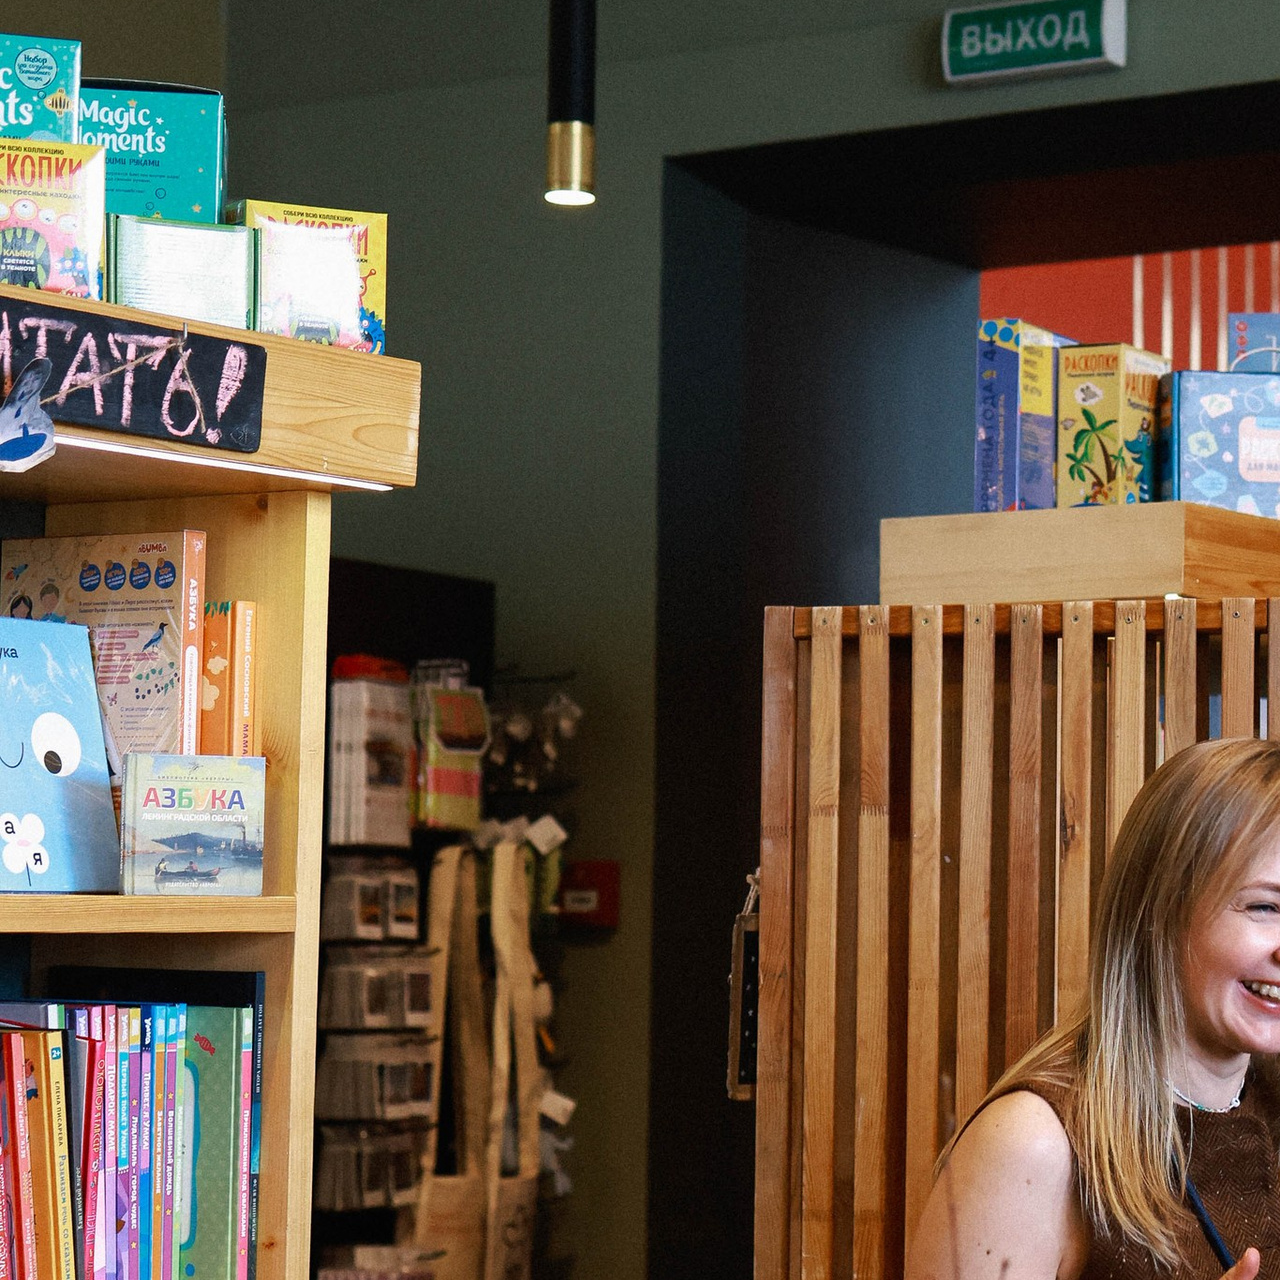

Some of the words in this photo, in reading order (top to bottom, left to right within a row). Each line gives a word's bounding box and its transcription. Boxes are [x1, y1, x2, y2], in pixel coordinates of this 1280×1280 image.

[960, 9, 1090, 58] ВЫХОД
[79, 98, 150, 133] Magic
[23, 146, 64, 155] КОЛЛЕКЦИЮ
[79, 125, 166, 154] oments
[283, 209, 304, 217] СОБЕРИ
[319, 214, 353, 222] КОЛЛЕКЦИЮ
[3, 249, 35, 258] КЛЫКИ
[1064, 354, 1118, 372] РАСКОПКИ
[188, 578, 198, 631] АЗБУКА
[244, 609, 254, 652] Евгений
[242, 654, 253, 717] Сосновский
[142, 787, 246, 811] АЗБУКА
[4, 820, 16, 834] а
[142, 813, 211, 822] ЛЕНИНГРАДСКОЙ
[211, 814, 249, 822] ОБЛАСТИ
[33, 852, 43, 865] я
[54, 1081, 62, 1106] ЕЛЕНА
[108, 1064, 116, 1116] ПОДАРОК
[120, 1061, 129, 1098] ПЕРВЫЙ
[55, 1107, 63, 1147] ПИСАРЕВА
[107, 1119, 116, 1153] МАМЕ
[166, 1110, 174, 1164] ВОЛШЕБНЫЙ
[242, 1110, 250, 1172] ПРИКЛЮЧЕНИЯ
